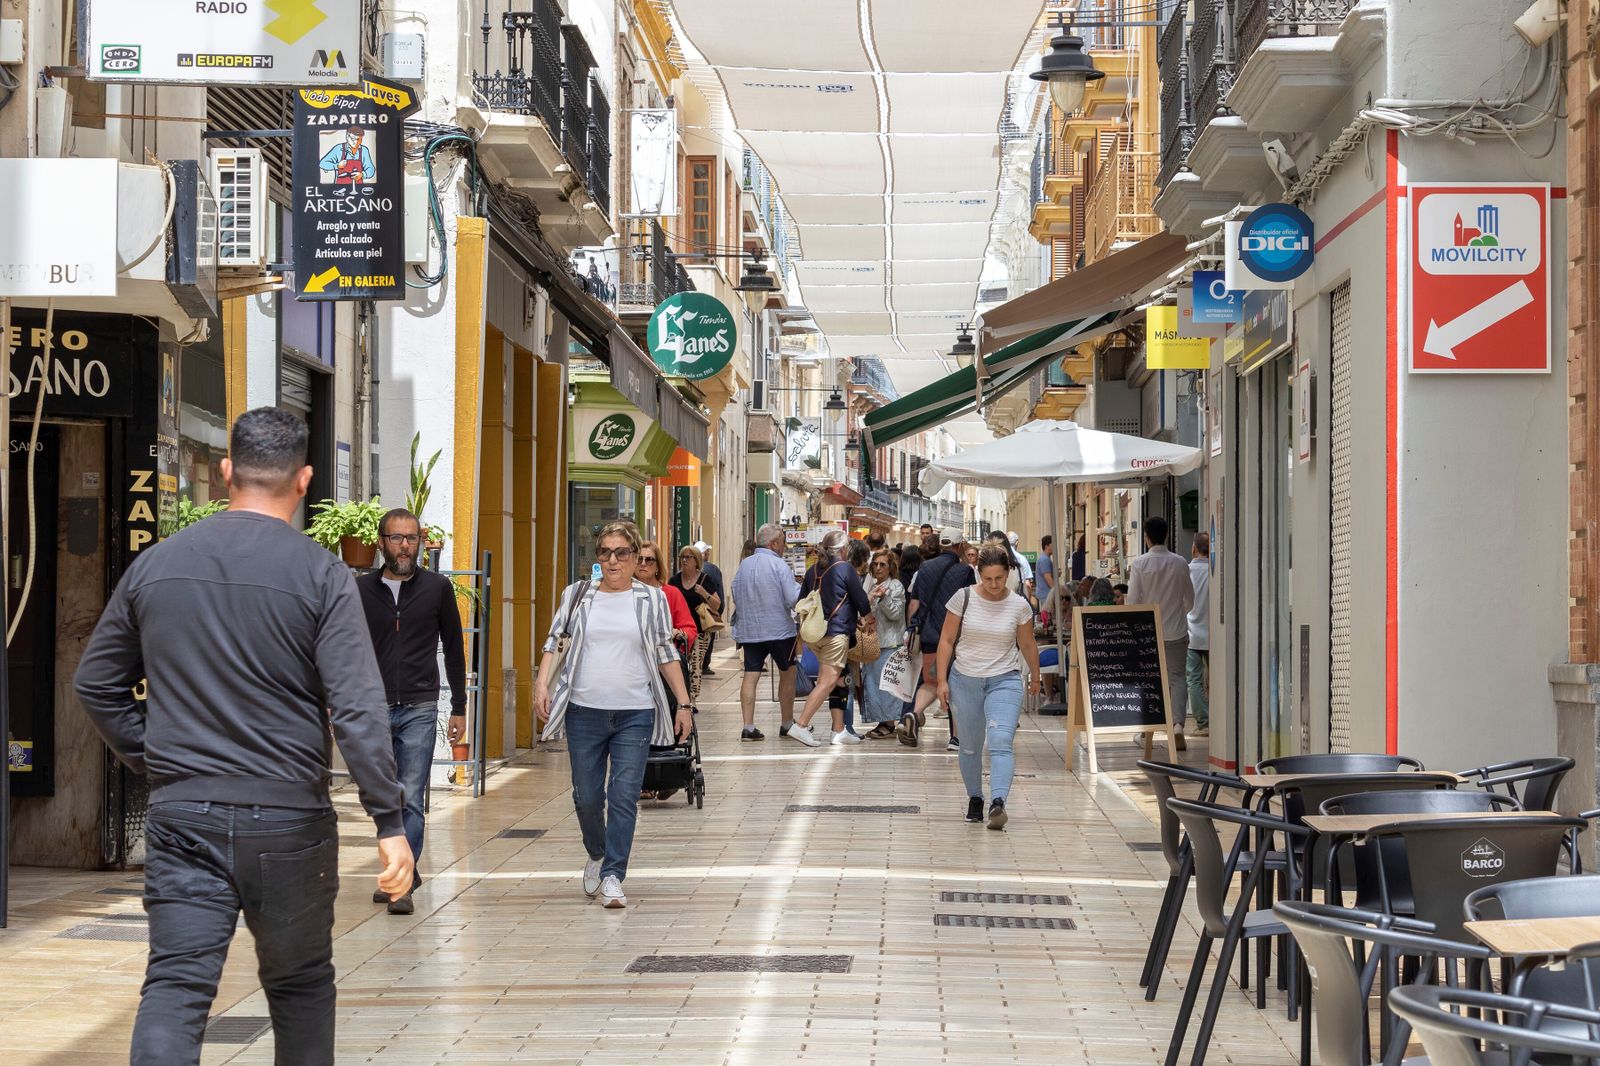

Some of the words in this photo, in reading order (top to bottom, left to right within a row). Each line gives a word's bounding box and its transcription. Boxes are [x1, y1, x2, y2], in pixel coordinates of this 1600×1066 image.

[195, 1, 248, 14] RADIO
[303, 89, 330, 103] Todo
[333, 95, 360, 110] tipo!
[306, 114, 389, 126] ZAPATERO
[305, 186, 323, 197] EL
[316, 220, 348, 233] Arreglo
[350, 223, 355, 232] y
[357, 221, 381, 230] venta
[325, 234, 338, 244] del
[340, 233, 373, 244] calzado
[1242, 236, 1309, 251] DIGI
[315, 248, 351, 258] Artículos
[353, 250, 364, 258] en
[366, 247, 383, 259] piel
[1431, 248, 1527, 262] MOVILCITY
[339, 276, 352, 287] EN
[354, 275, 396, 287] GALERIA
[883, 668, 898, 678] you
[885, 663, 906, 673] make
[1463, 858, 1503, 869] BARCO
